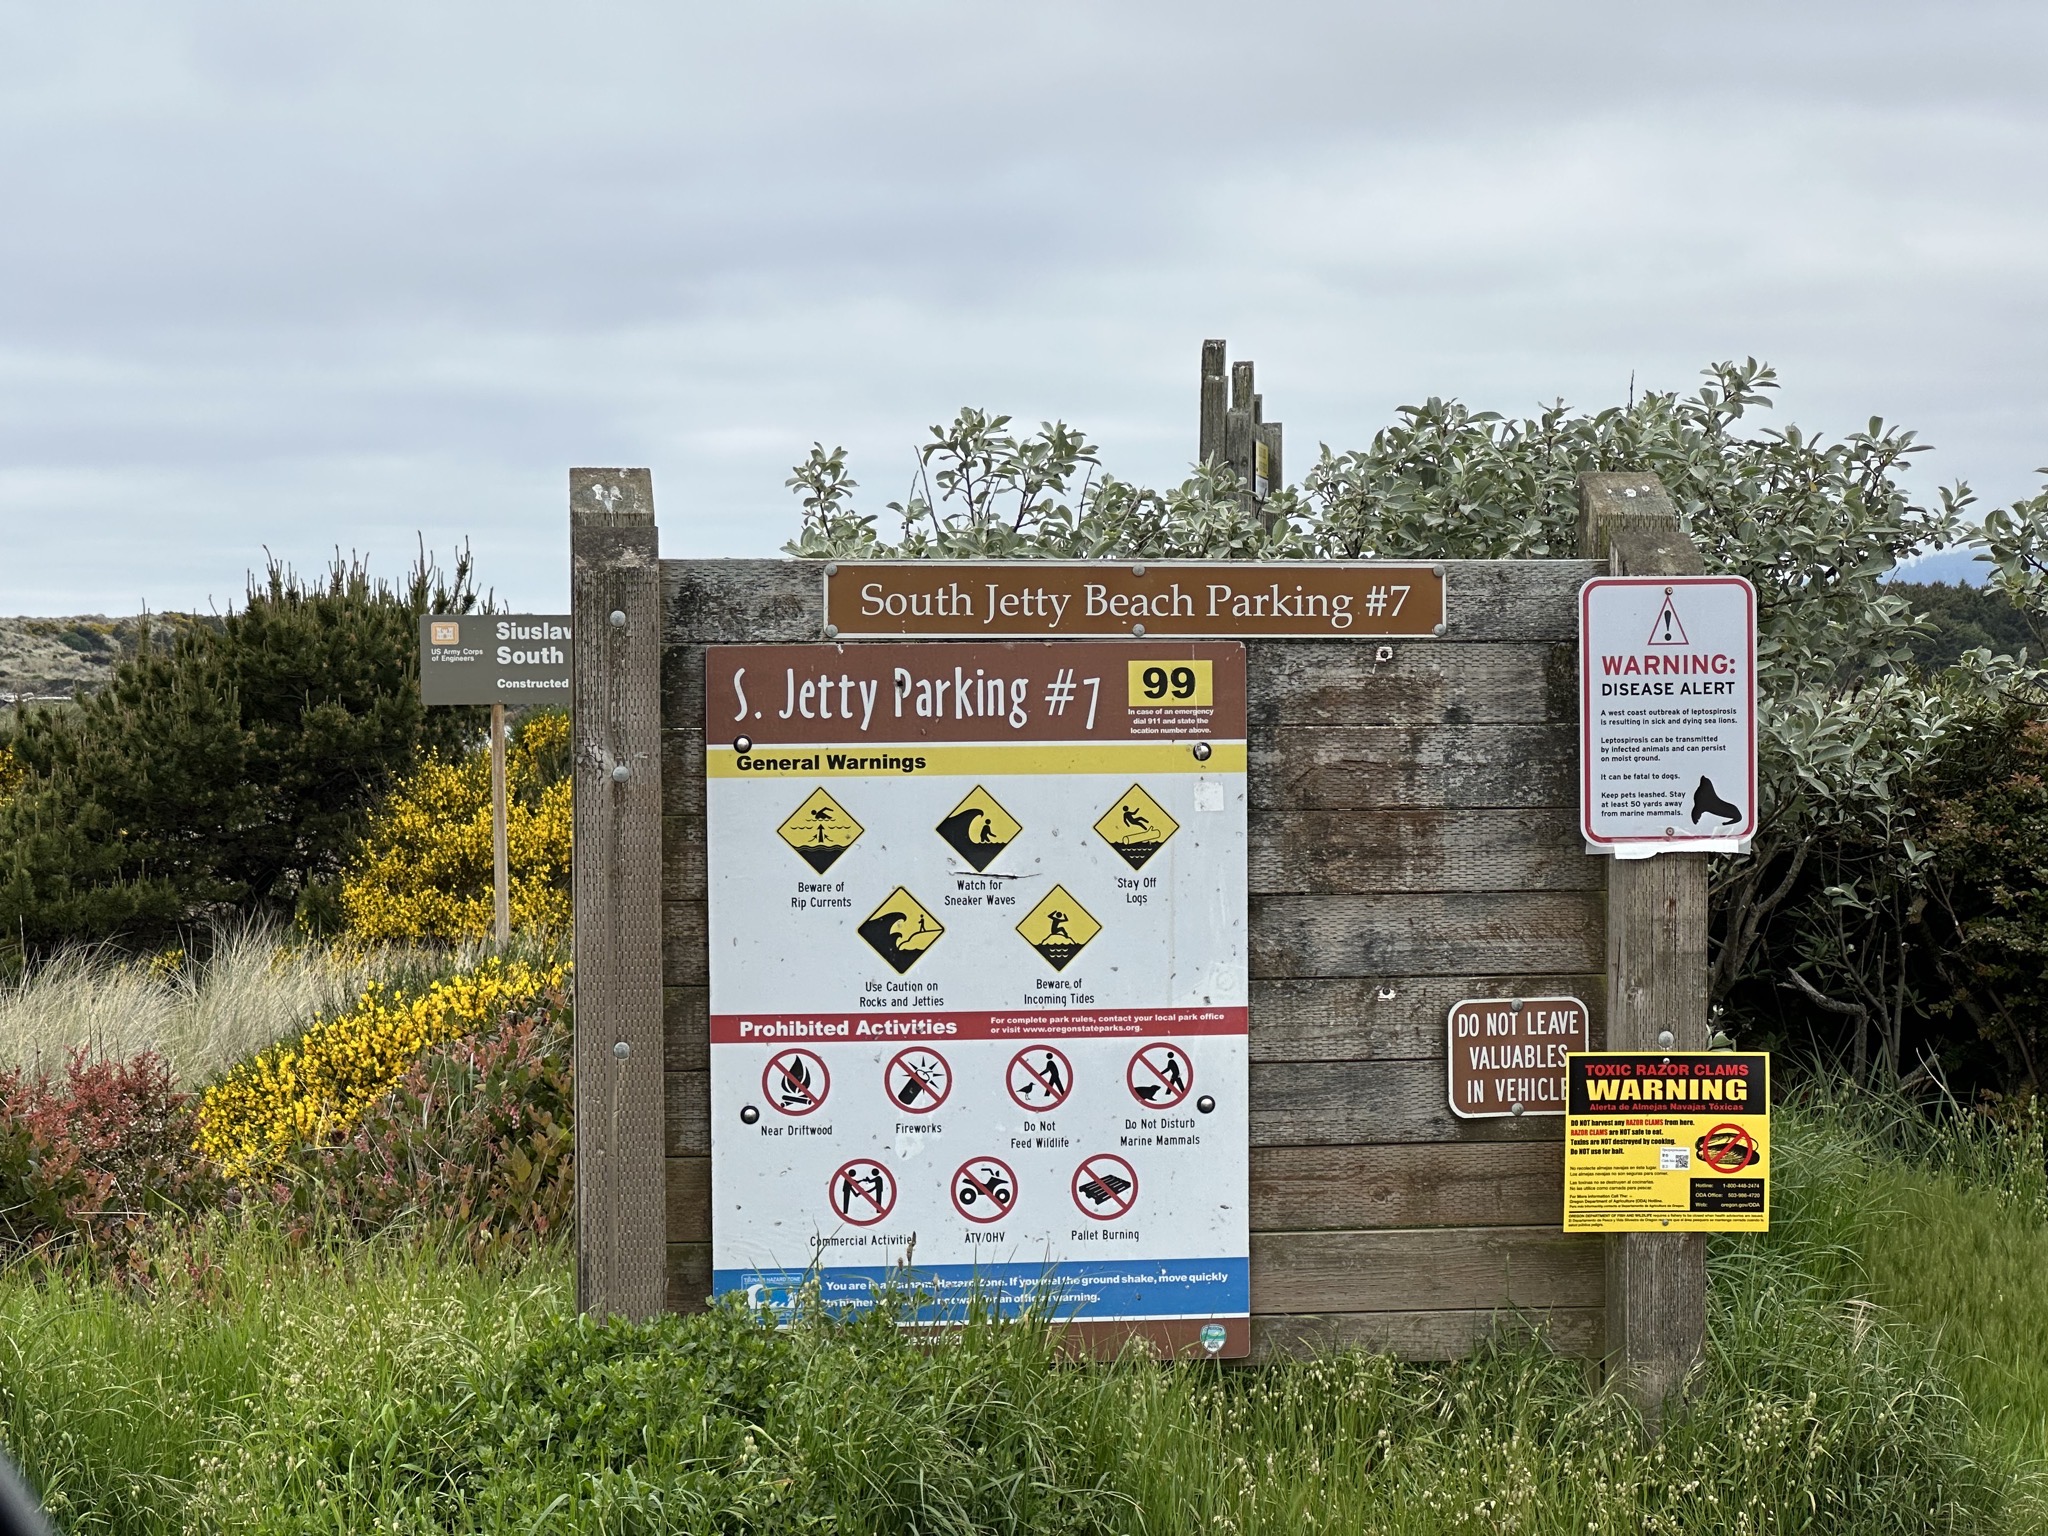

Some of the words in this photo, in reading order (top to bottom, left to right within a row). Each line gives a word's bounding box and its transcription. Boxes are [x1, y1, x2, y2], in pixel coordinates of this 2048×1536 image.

[861, 582, 974, 616] South
[984, 584, 1071, 628] Jetty
[1083, 584, 1195, 616] Beach
[1206, 584, 1353, 628] Parking
[1366, 586, 1410, 616] #7
[497, 646, 563, 664] South
[1602, 654, 1735, 675] WARNING:
[497, 679, 569, 688] Constructed
[1143, 667, 1195, 699] 99
[1602, 683, 1674, 696] DISEASE
[1680, 682, 1735, 695] ALERT
[733, 668, 762, 721] S.
[779, 668, 877, 731] Jetty
[894, 667, 1029, 729] Parking
[1044, 668, 1100, 730] #7
[736, 755, 819, 771] General
[827, 754, 926, 773] Warnings
[798, 882, 832, 892] Beware
[836, 882, 844, 892] of
[957, 880, 985, 890] Watch
[989, 880, 1003, 890] for
[1118, 878, 1139, 890] Stay
[1143, 877, 1156, 887] Off
[792, 898, 806, 910] Rip
[810, 897, 851, 907] Currents
[944, 896, 982, 905] Sneaker
[987, 895, 1015, 905] Waves
[1127, 893, 1147, 906] Logs
[865, 982, 882, 991] Use
[886, 981, 922, 992] Caution
[927, 982, 938, 991] on
[1036, 979, 1069, 989] Beware
[1074, 979, 1082, 988] of
[860, 997, 886, 1007] Rocks
[891, 997, 908, 1007] and
[913, 996, 944, 1006] Jetties
[1024, 994, 1066, 1006] Incoming
[1070, 994, 1094, 1004] Tides
[1007, 1016, 1047, 1025] complete
[1050, 1016, 1069, 1024] park
[1072, 1016, 1096, 1024] rules,
[1133, 1015, 1153, 1023] your
[1178, 1014, 1197, 1022] park
[1459, 1013, 1479, 1037] DO
[1487, 1012, 1518, 1036] NOT
[1527, 1011, 1579, 1035] LEAVE
[740, 1020, 848, 1037] Prohibited
[856, 1019, 957, 1036] Activities
[1023, 1024, 1142, 1034] www.oregonstateparks.org.
[1470, 1044, 1567, 1069] VALUABLES
[1585, 1064, 1631, 1076] TOXIC
[1636, 1064, 1689, 1076] RAZOR
[1694, 1064, 1749, 1075] CLAMS
[1468, 1080, 1483, 1103] IN
[1586, 1079, 1747, 1101] WARNING
[1632, 1103, 1667, 1111] Almejas
[1670, 1103, 1705, 1111] Navajas
[761, 1126, 783, 1136] Near
[788, 1125, 832, 1135] Driftwood
[896, 1123, 941, 1133] Fireworks
[1024, 1121, 1035, 1131] Do
[1040, 1121, 1055, 1131] Not
[1126, 1119, 1137, 1130] Do
[1141, 1119, 1157, 1129] Not
[1161, 1119, 1195, 1129] Disturb
[1011, 1139, 1031, 1148] Feed
[1036, 1138, 1069, 1148] Wildlife
[1121, 1136, 1151, 1146] Marine
[1156, 1135, 1200, 1146] Mammals
[810, 1236, 867, 1247] Commercial
[871, 1235, 915, 1245] Activitie
[965, 1232, 1005, 1243] ATV/OHV
[1071, 1230, 1098, 1241] Pallet
[1103, 1230, 1139, 1241] Burning
[826, 1282, 846, 1290] You
[849, 1282, 867, 1290] are
[1010, 1277, 1017, 1286] If
[1082, 1274, 1119, 1286] ground
[1121, 1274, 1156, 1284] shake,
[1159, 1273, 1187, 1283] move
[1189, 1272, 1228, 1283] quickly
